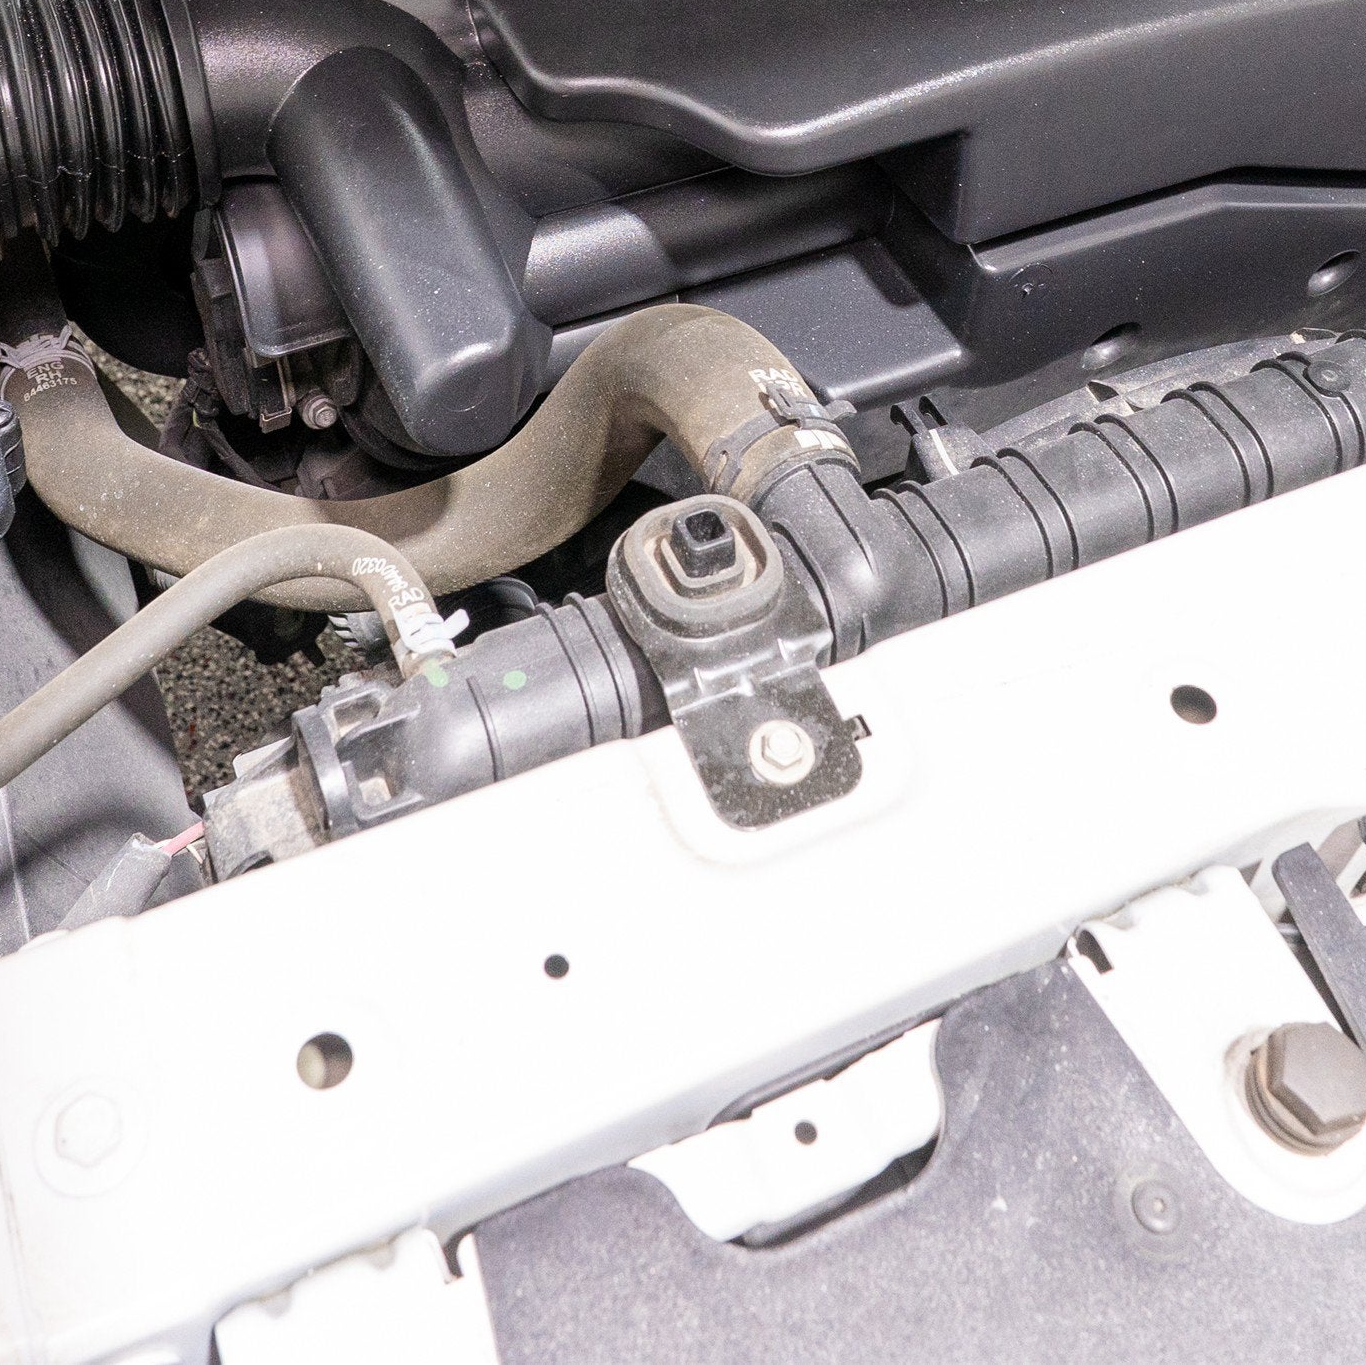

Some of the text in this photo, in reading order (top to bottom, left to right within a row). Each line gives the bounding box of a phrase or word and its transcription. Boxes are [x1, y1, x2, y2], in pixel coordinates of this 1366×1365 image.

[26, 361, 65, 380] ENG
[35, 370, 62, 384] RH
[748, 368, 801, 383] RAD
[388, 587, 425, 611] RAD
